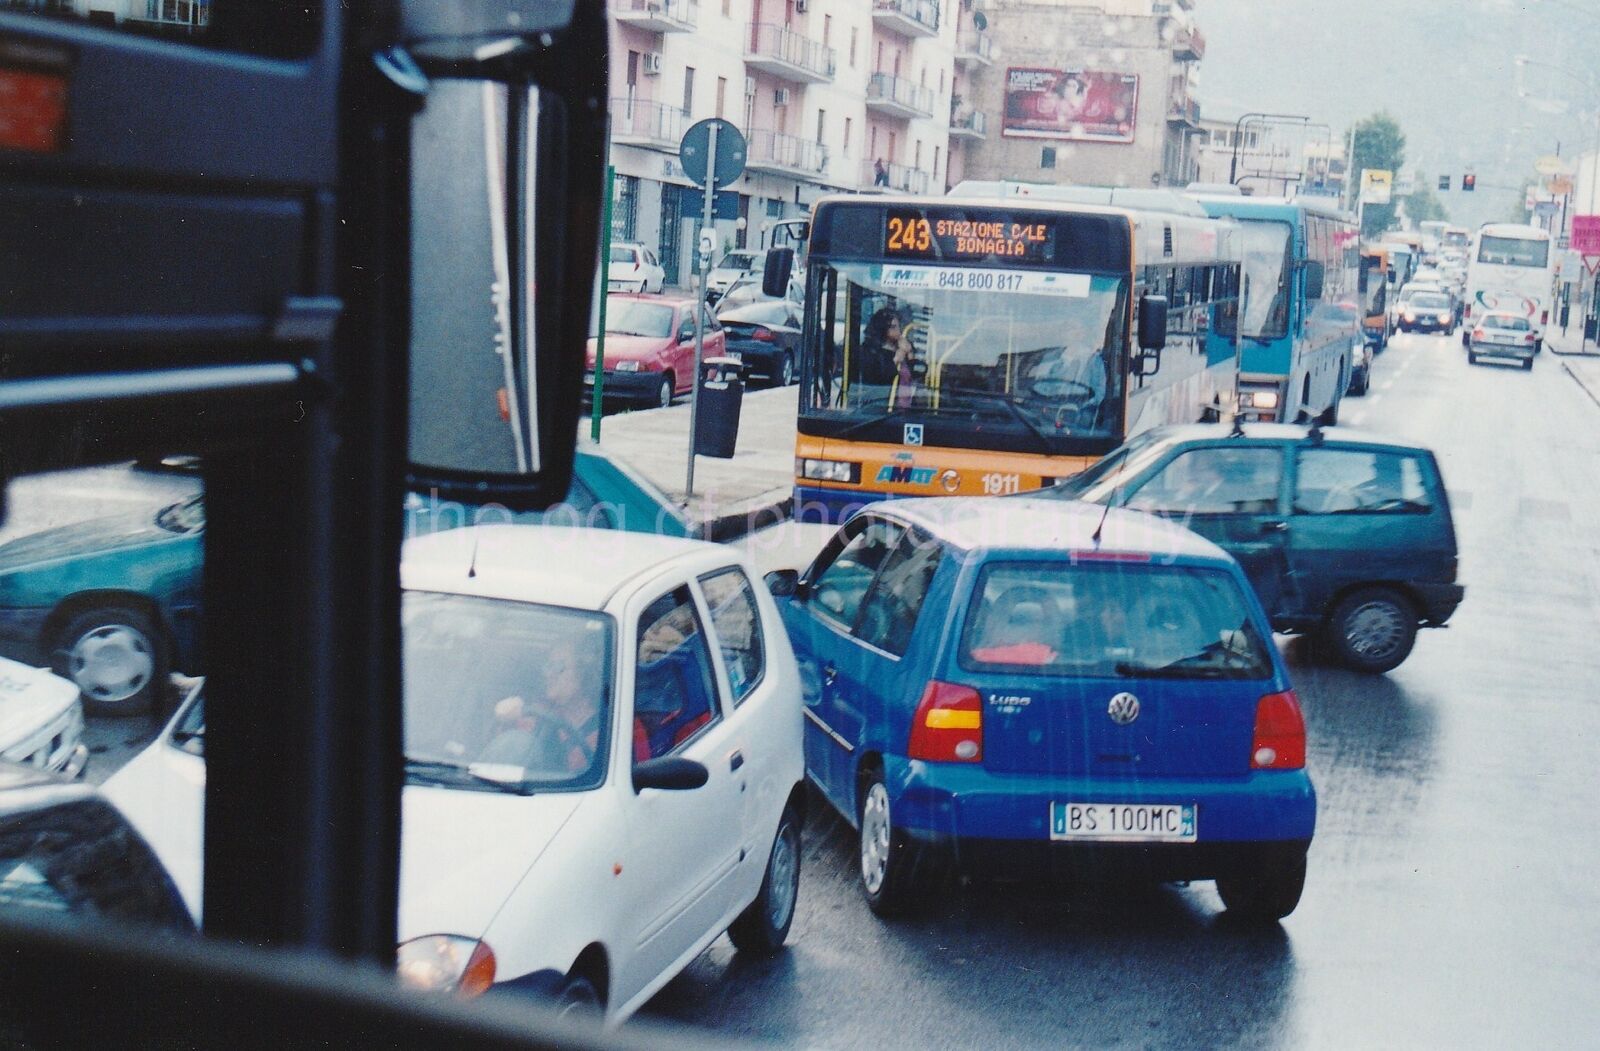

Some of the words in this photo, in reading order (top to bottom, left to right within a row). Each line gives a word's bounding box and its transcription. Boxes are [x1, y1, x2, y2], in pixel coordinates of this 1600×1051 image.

[888, 218, 929, 250] 243
[936, 222, 1004, 238] STAZIONE
[1011, 224, 1047, 241] C/LE
[957, 239, 1025, 256] BONAGIA
[938, 271, 963, 288] 848
[968, 273, 993, 290] 800
[997, 275, 1023, 291] 817
[876, 465, 939, 485] AMAT
[981, 473, 1020, 495] 1911
[1070, 807, 1097, 831] BS
[1109, 808, 1178, 832] 100MC
